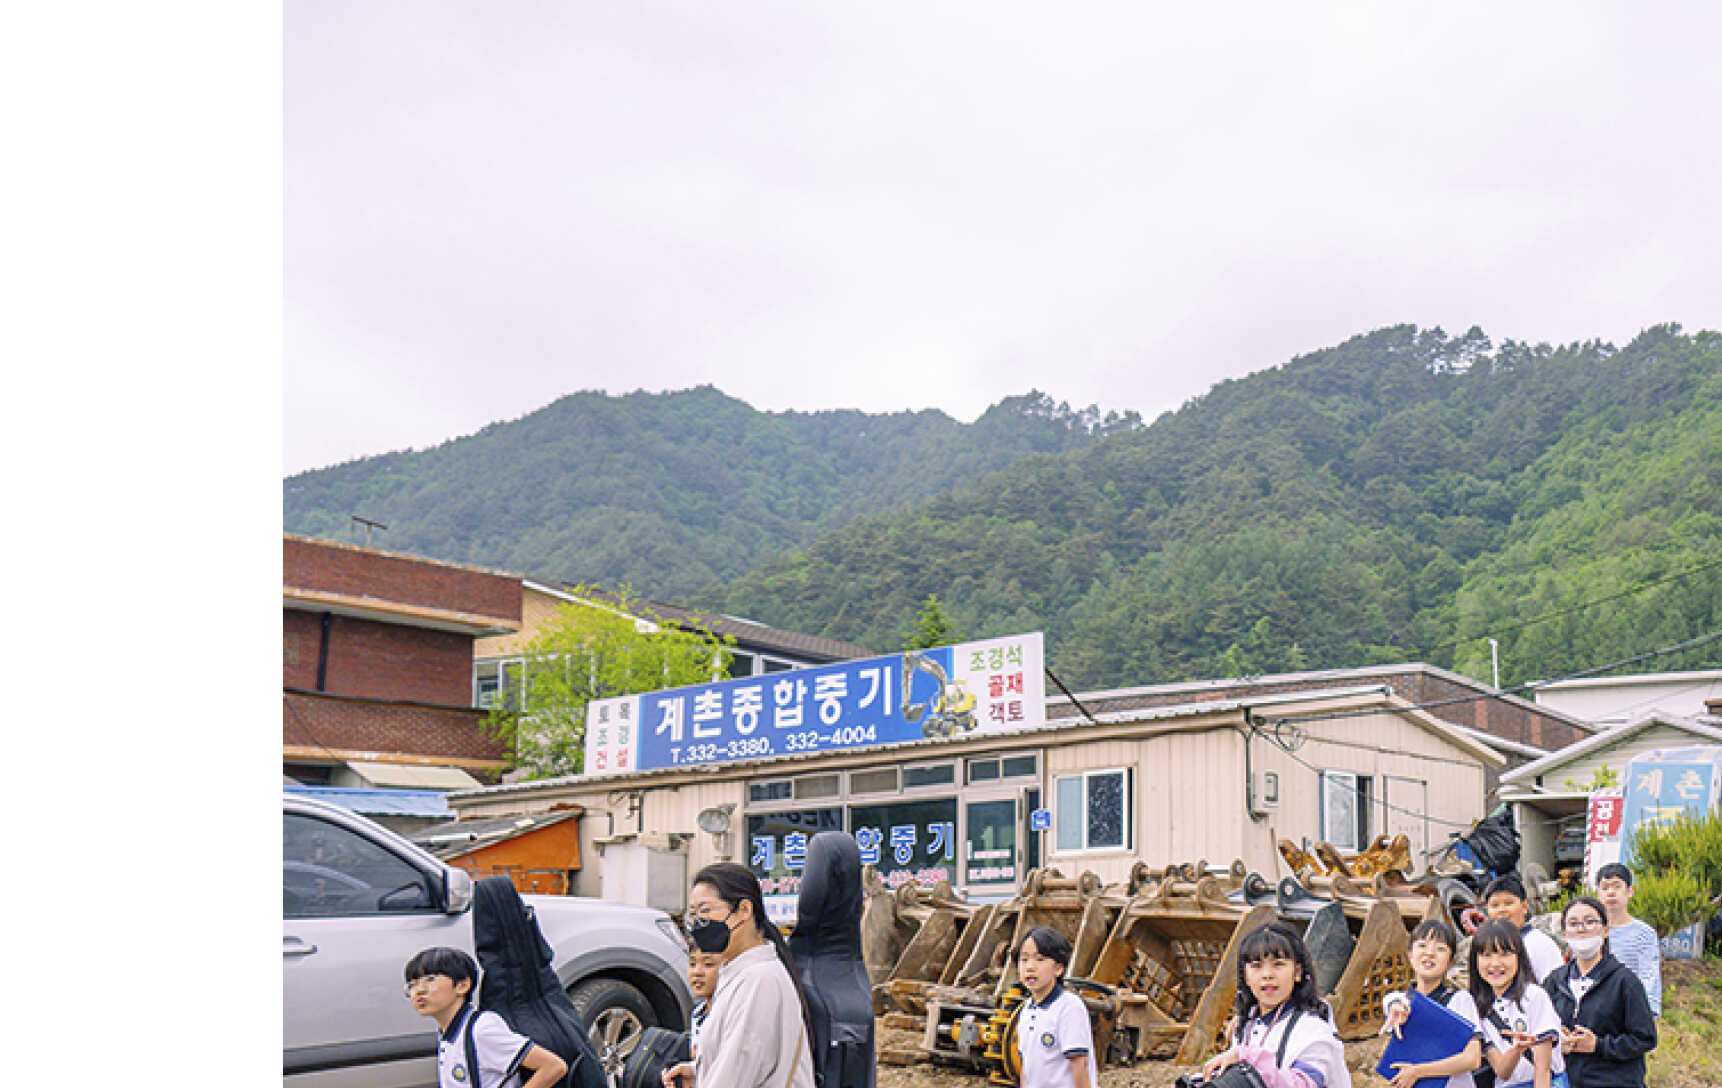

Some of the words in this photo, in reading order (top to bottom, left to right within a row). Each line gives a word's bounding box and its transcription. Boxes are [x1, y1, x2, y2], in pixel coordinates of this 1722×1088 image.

[970, 644, 1023, 671] 조경석
[655, 666, 893, 742] 계촌종합중기
[785, 724, 877, 750] 332-4004
